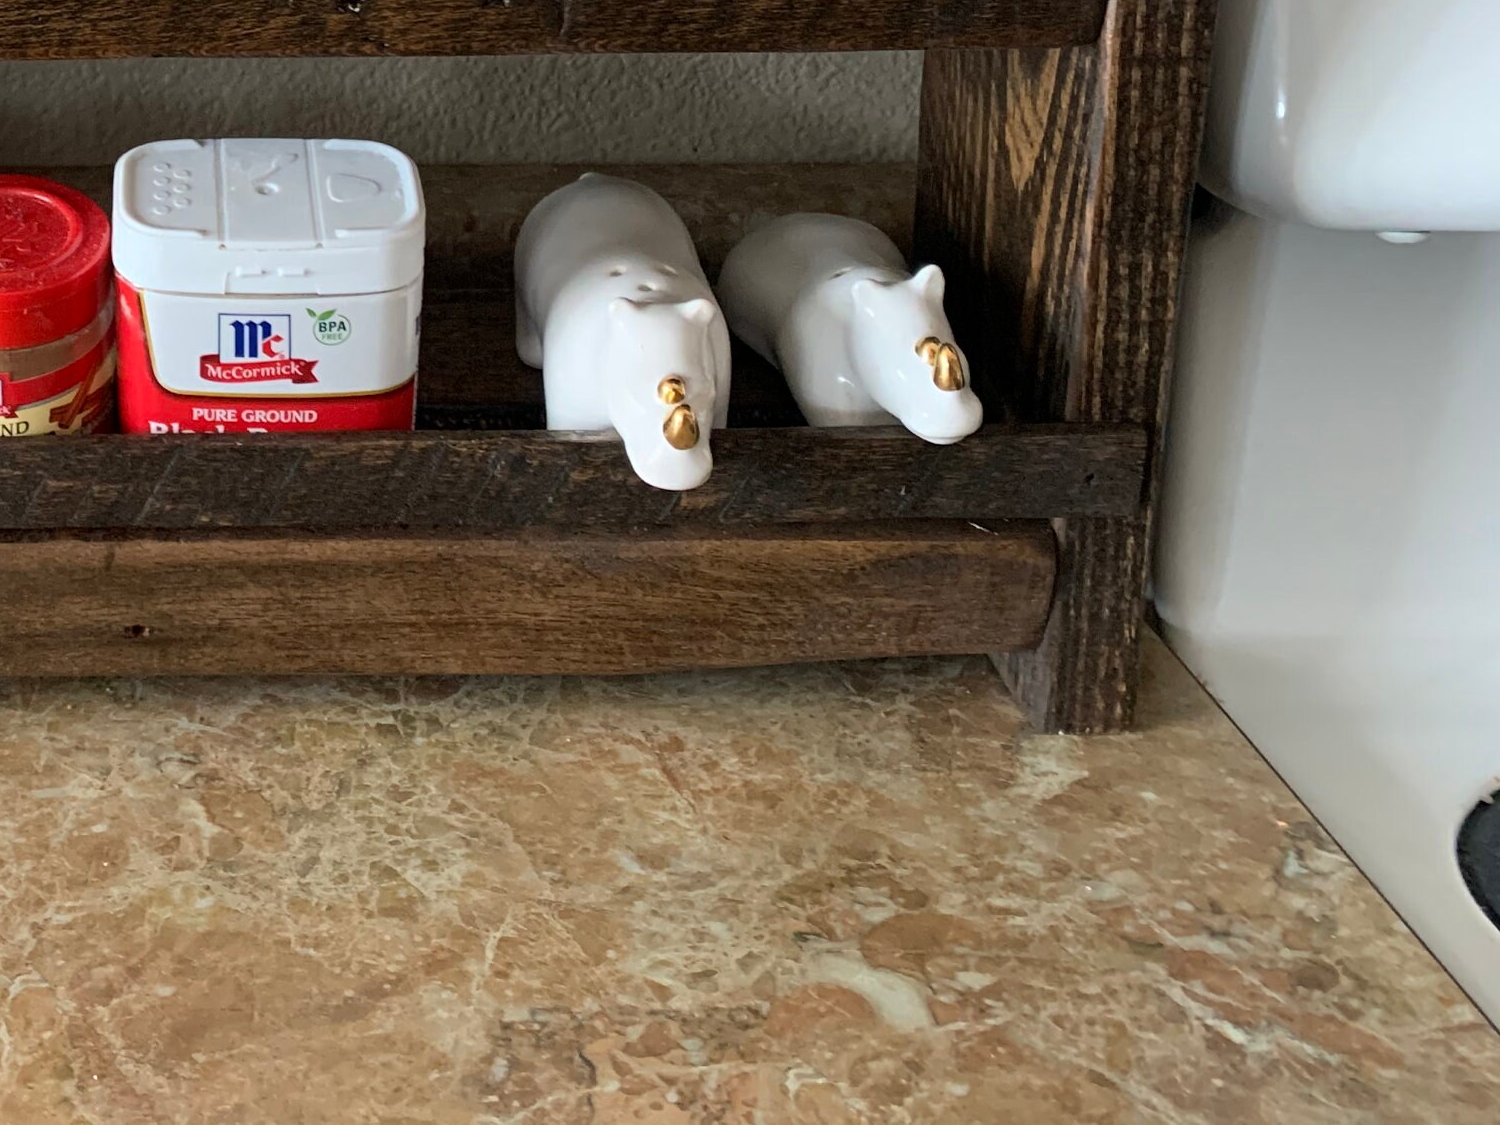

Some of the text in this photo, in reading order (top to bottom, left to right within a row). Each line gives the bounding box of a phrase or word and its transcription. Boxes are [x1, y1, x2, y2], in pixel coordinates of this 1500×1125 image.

[317, 320, 348, 334] BPA
[320, 332, 344, 341] FREE
[204, 361, 304, 381] McCormick
[192, 407, 319, 424] PURE GROUND
